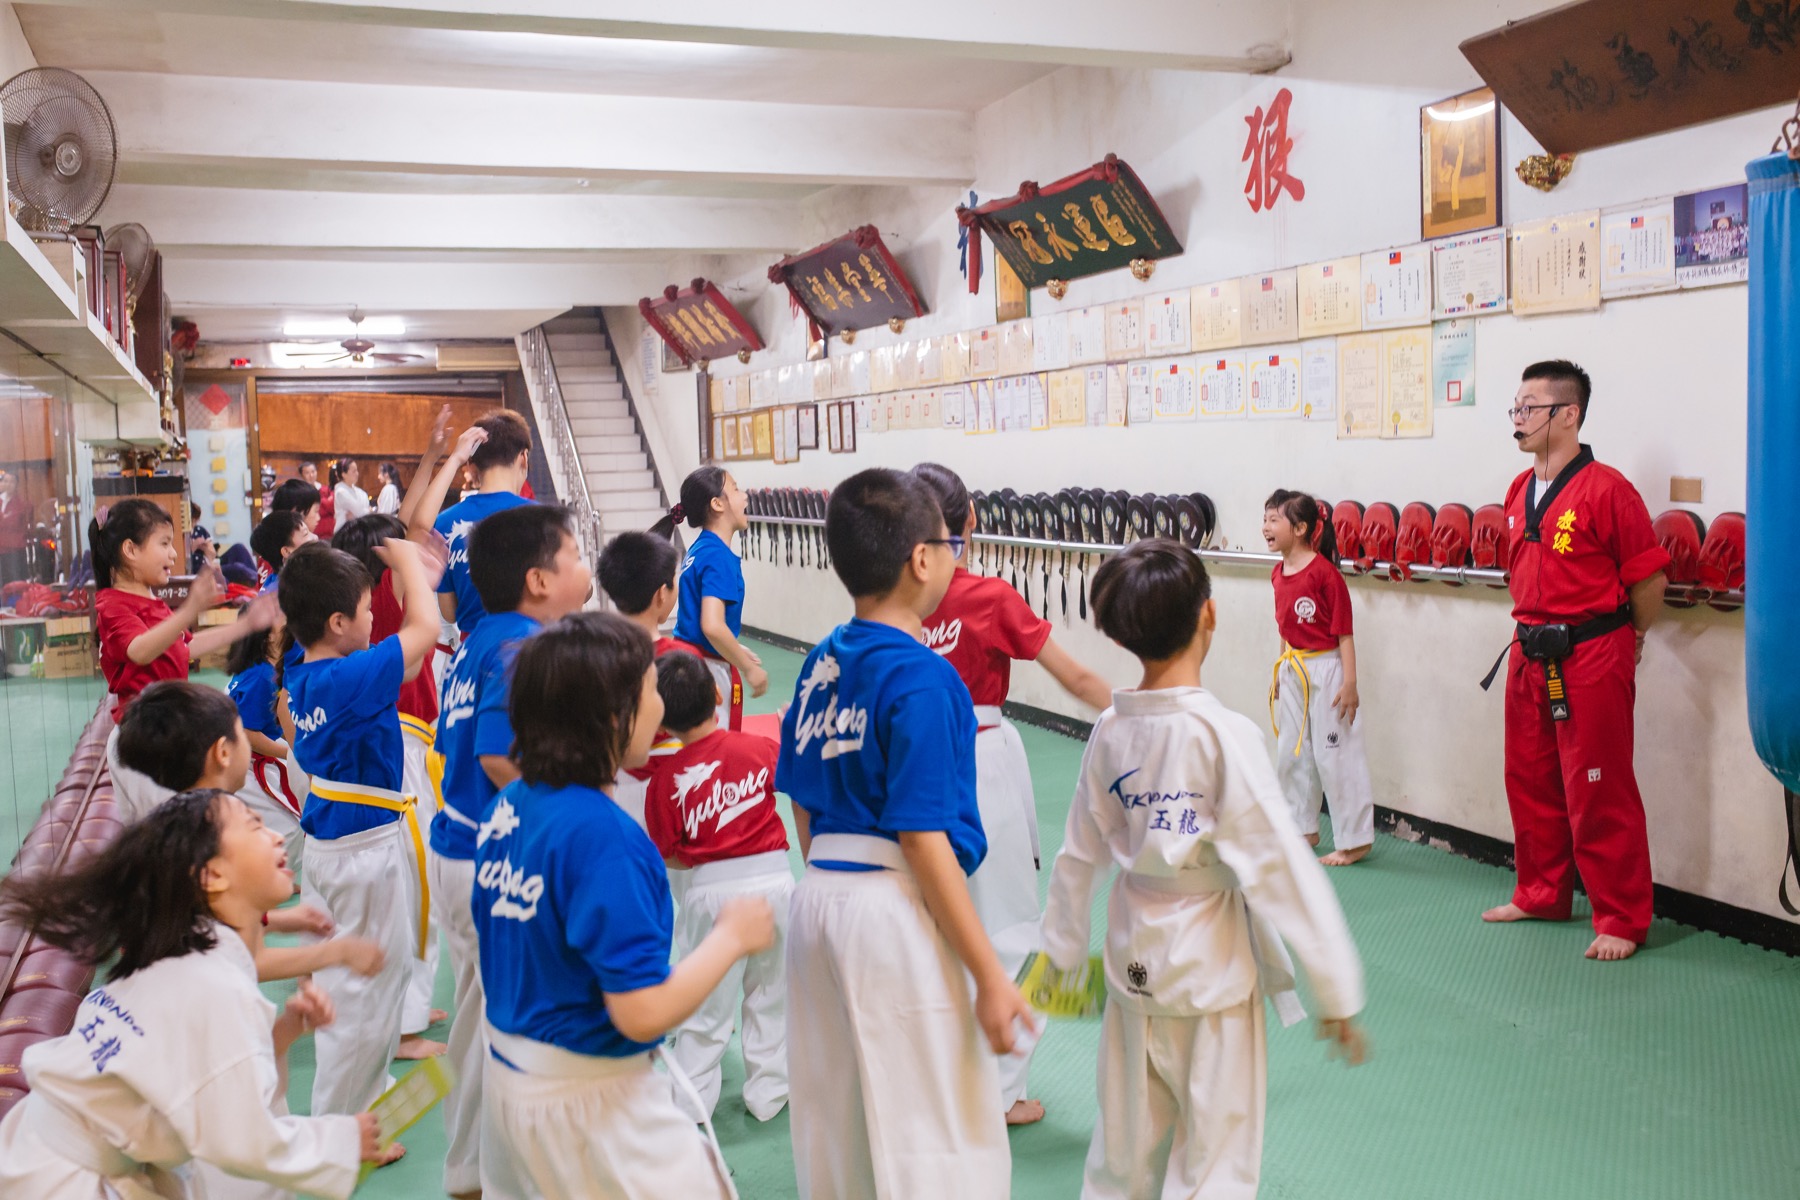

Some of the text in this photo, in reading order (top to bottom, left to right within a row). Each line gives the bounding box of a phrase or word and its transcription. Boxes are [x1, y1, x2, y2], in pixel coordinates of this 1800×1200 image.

[1552, 508, 1577, 554] 教練
[1149, 808, 1200, 835] 玉龍
[78, 1016, 122, 1074] 玉龍
